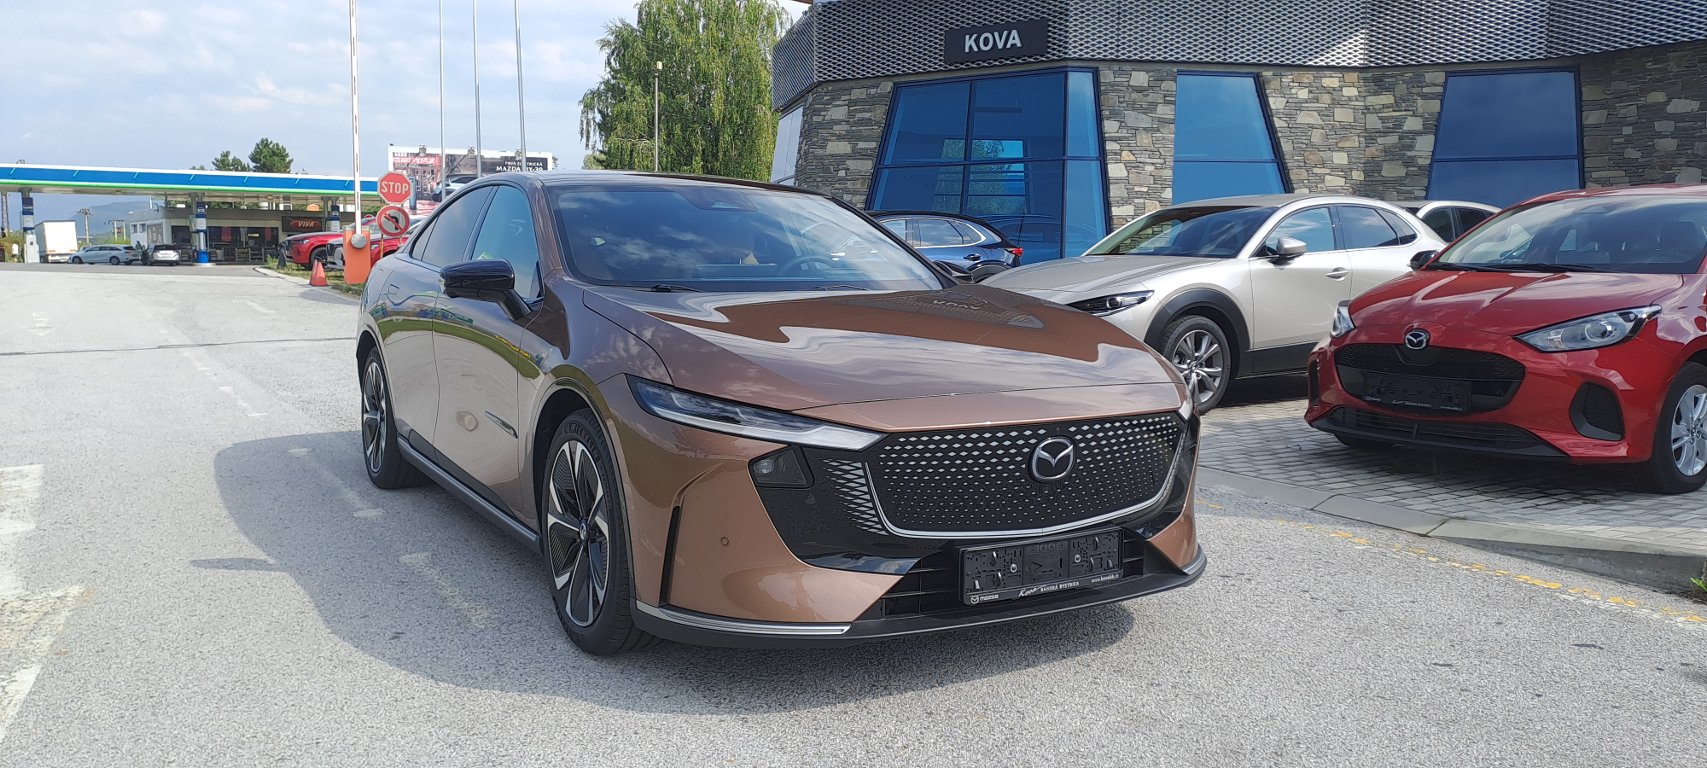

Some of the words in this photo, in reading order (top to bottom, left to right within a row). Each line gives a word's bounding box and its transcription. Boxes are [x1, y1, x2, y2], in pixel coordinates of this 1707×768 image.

[964, 29, 1022, 53] KOVA
[381, 181, 409, 194] STOP
[298, 220, 315, 228] VIVA
